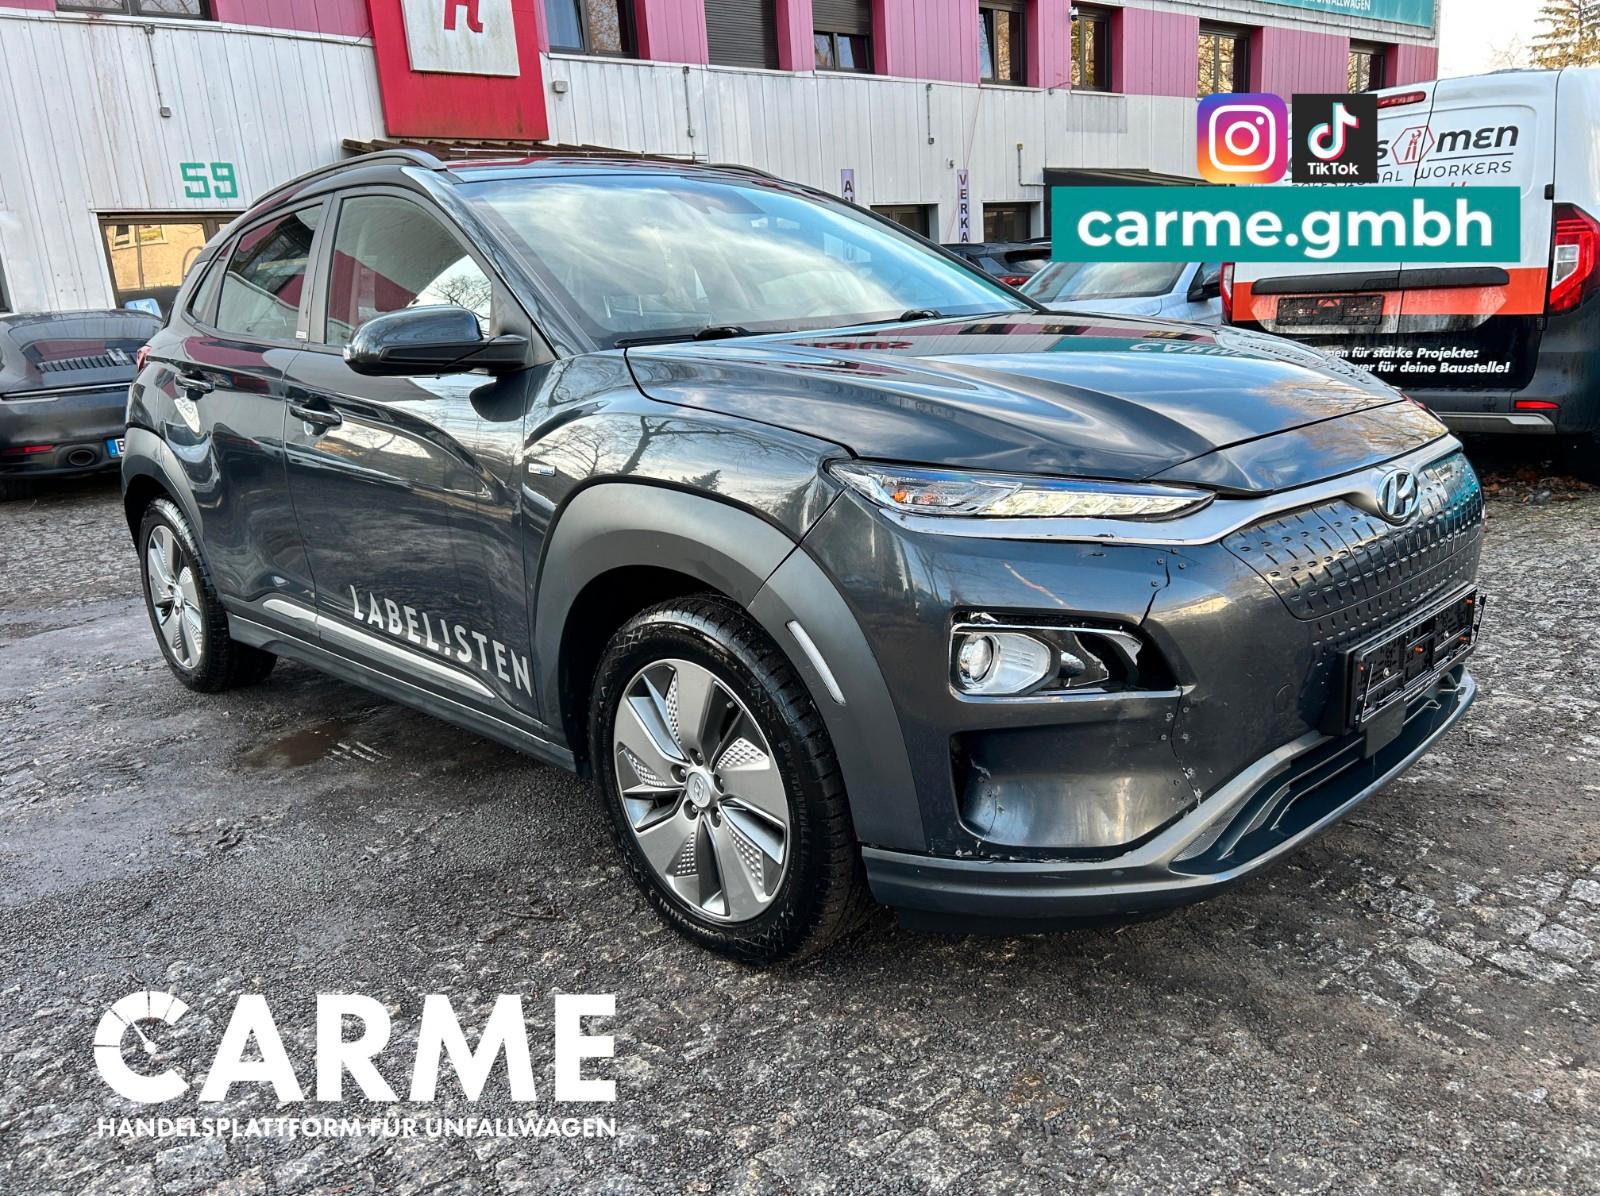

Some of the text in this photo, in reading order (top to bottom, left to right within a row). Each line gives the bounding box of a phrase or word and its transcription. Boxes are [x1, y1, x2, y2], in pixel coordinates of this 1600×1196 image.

[1414, 160, 1512, 180] WORKERS
[179, 162, 238, 199] 59
[1352, 346, 1370, 358] für
[1372, 346, 1414, 358] starke
[1416, 346, 1480, 361] Projekte:
[1378, 361, 1397, 372] für
[1399, 361, 1437, 373] deine
[1439, 360, 1511, 373] Baustelle!
